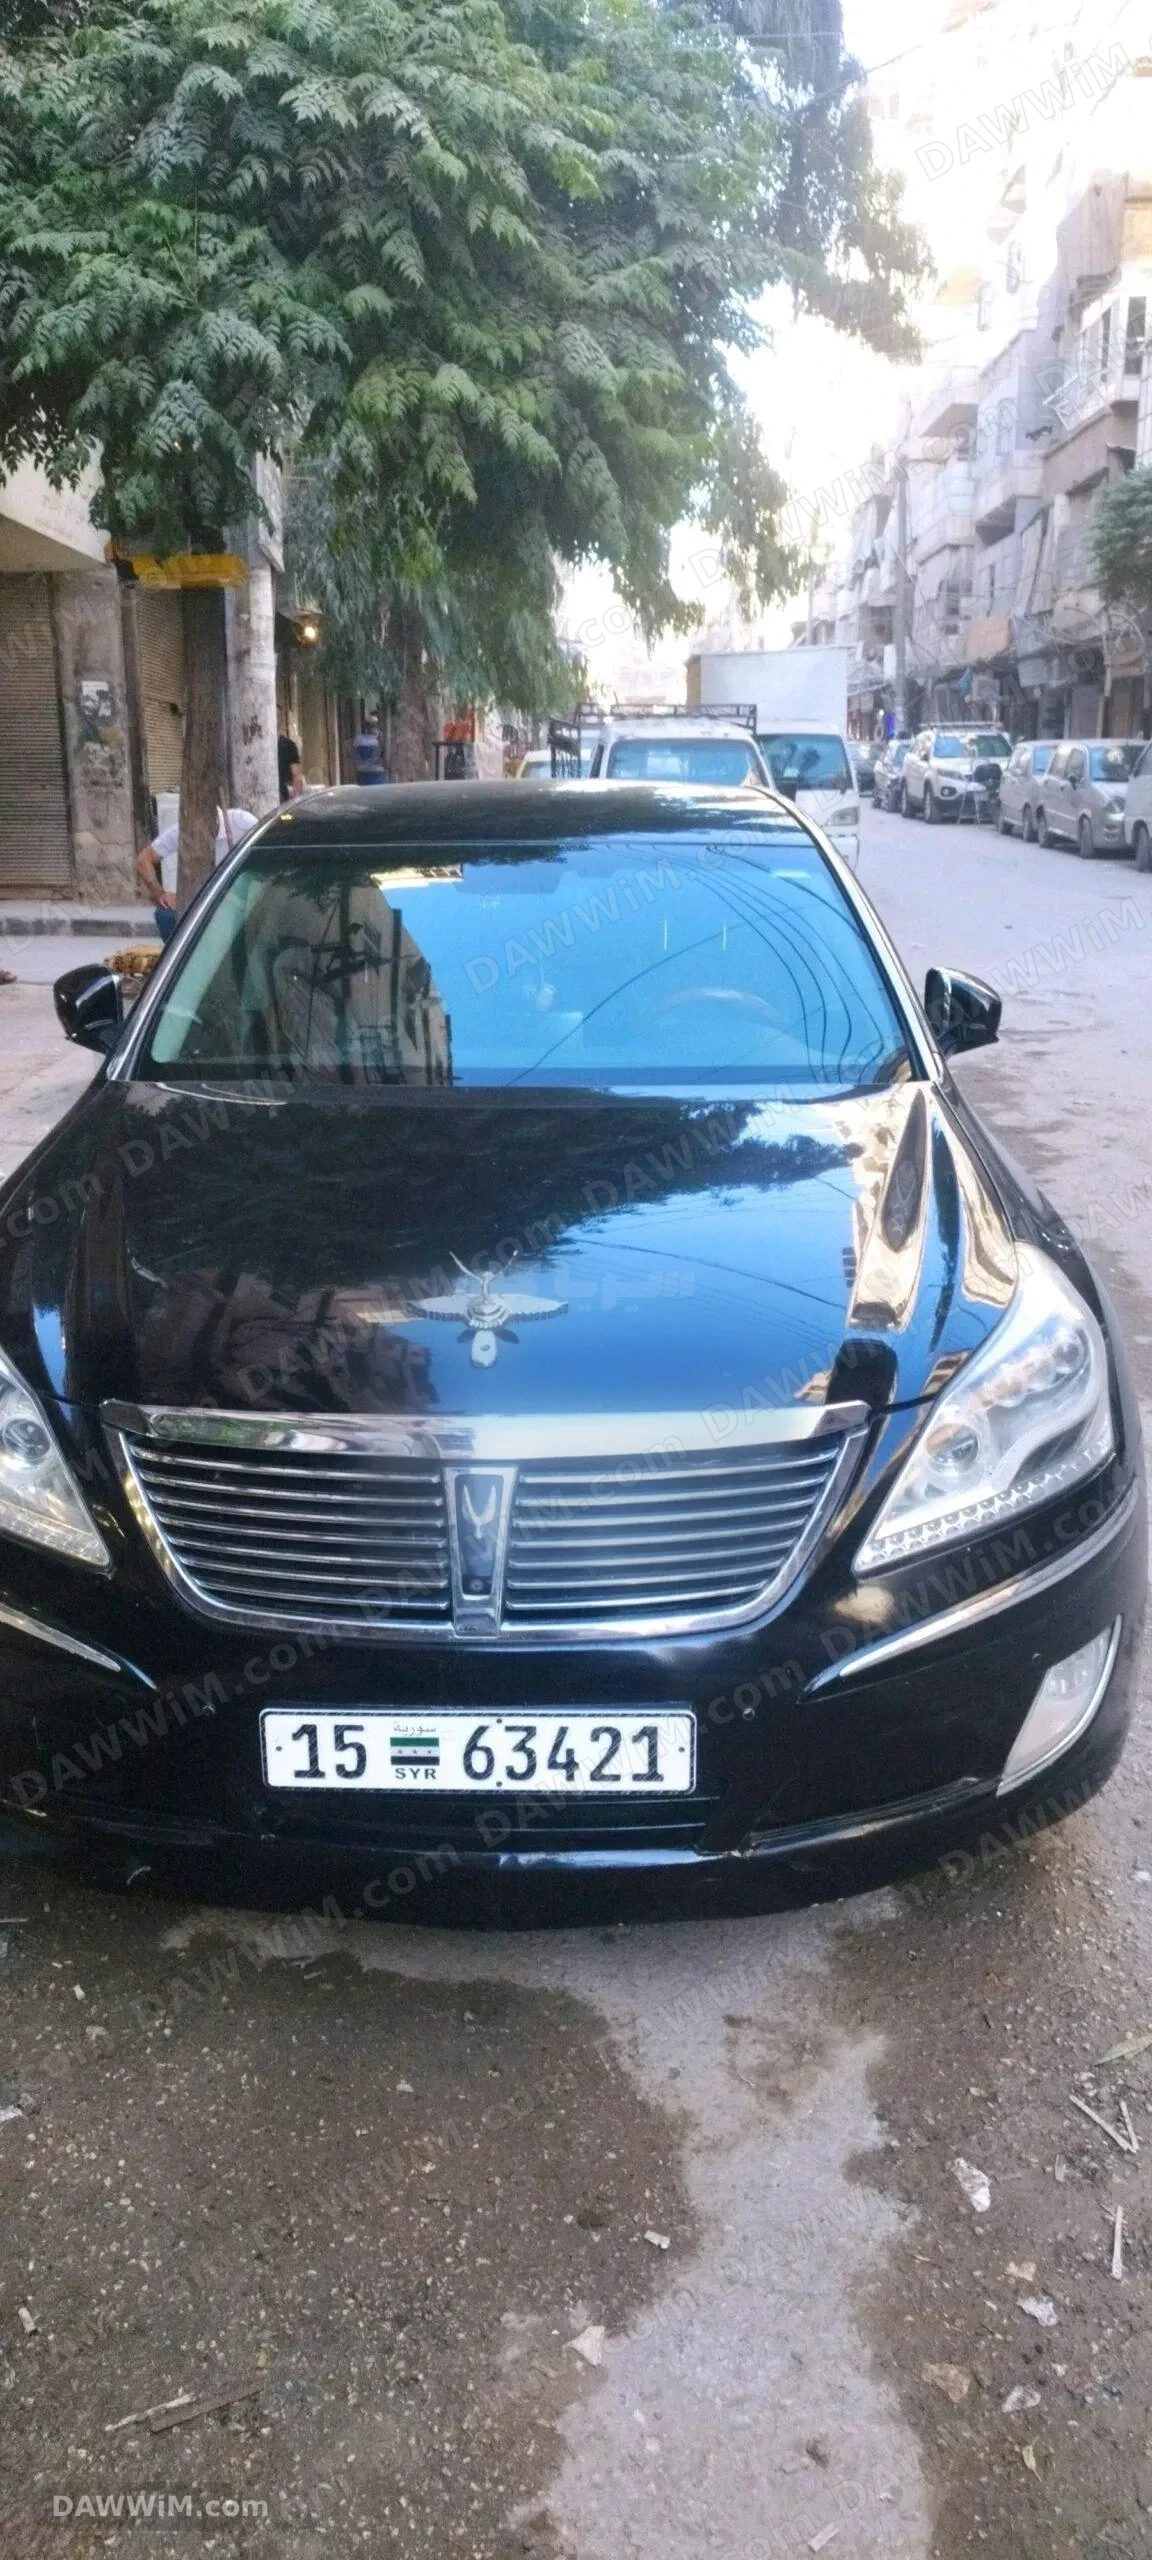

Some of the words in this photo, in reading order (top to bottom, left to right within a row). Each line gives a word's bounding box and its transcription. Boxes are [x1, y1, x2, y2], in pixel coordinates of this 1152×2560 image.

[291, 1723, 368, 1780] 15
[462, 1725, 665, 1782] 63421
[394, 1767, 437, 1780] SYR
